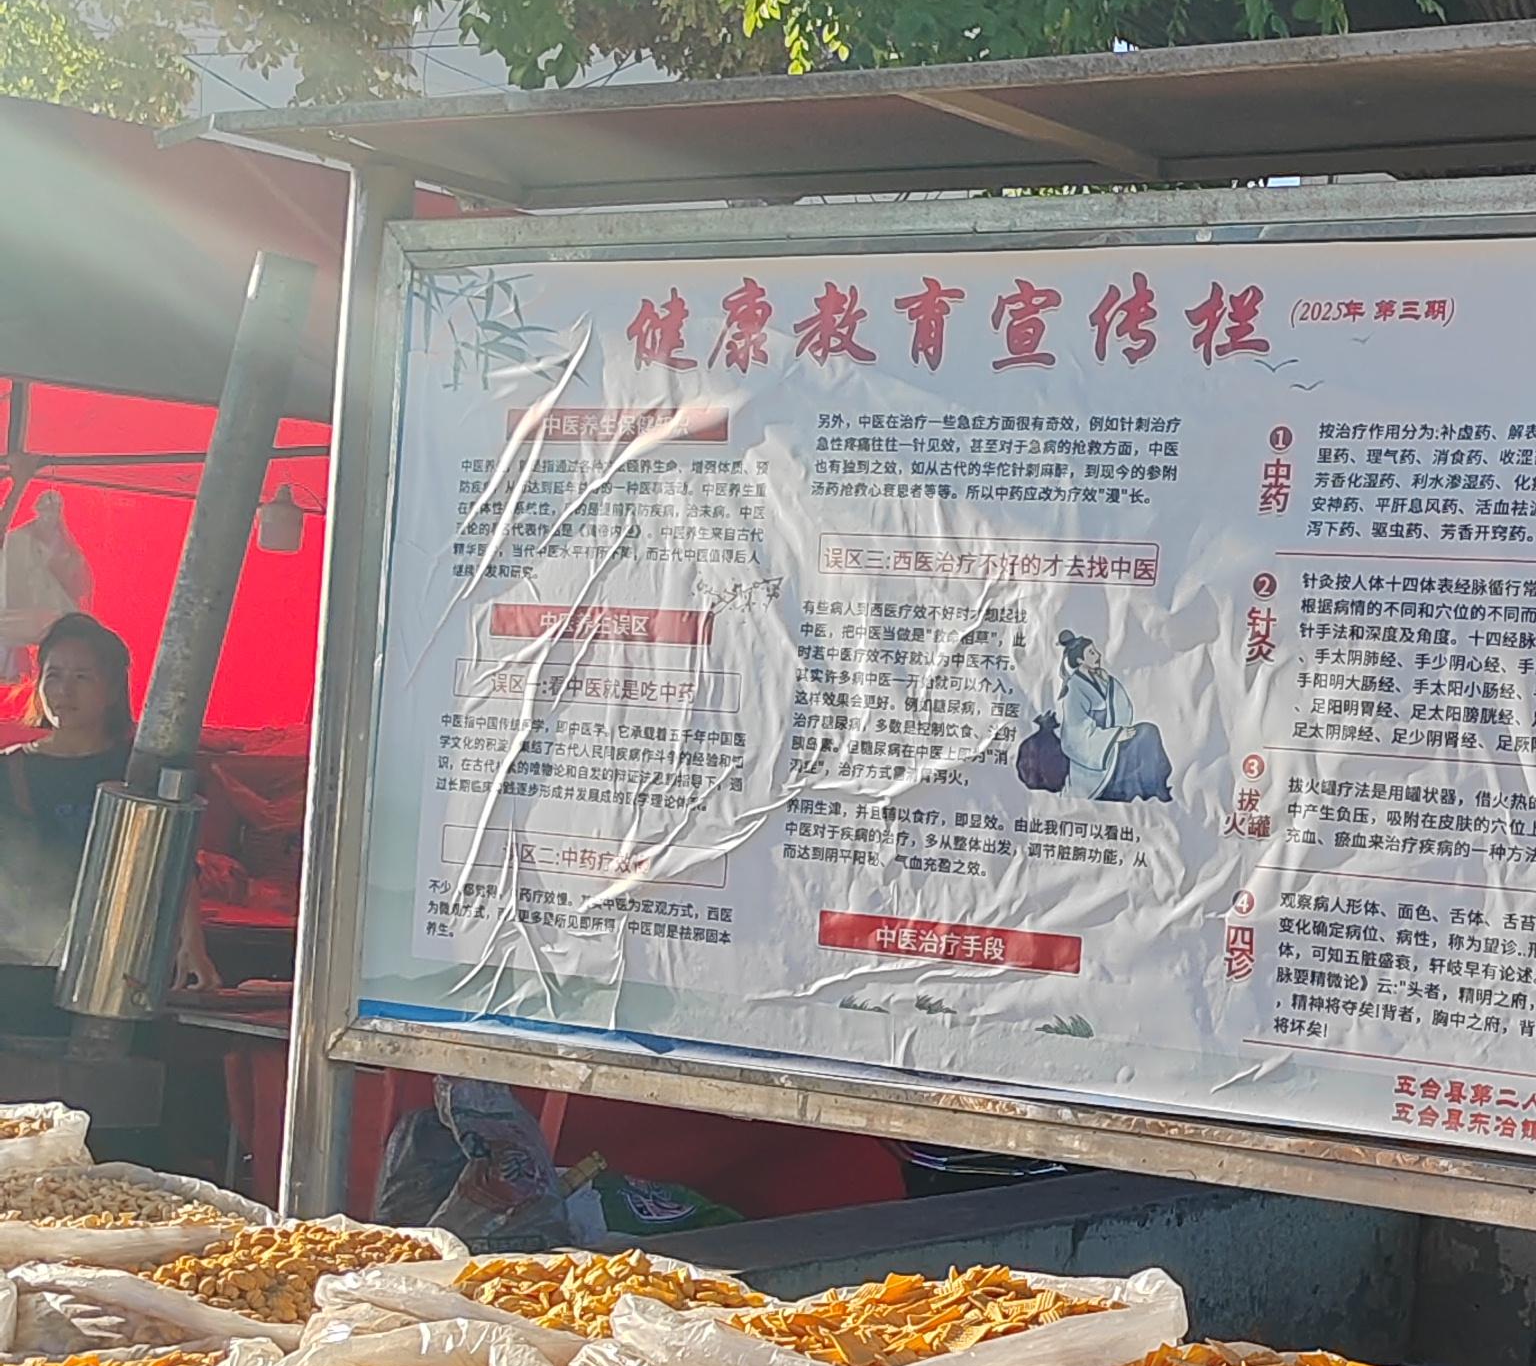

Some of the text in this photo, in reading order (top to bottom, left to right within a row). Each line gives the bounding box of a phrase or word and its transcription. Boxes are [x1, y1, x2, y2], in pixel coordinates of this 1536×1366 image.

[627, 272, 1271, 371] 健康教育宣传栏
[1289, 295, 1456, 327] (2025年 第三期)
[1258, 459, 1291, 515] 中药
[1246, 607, 1277, 664] 针灸
[875, 925, 1006, 961] 中医治疗手段
[1223, 924, 1257, 981] 四诊
